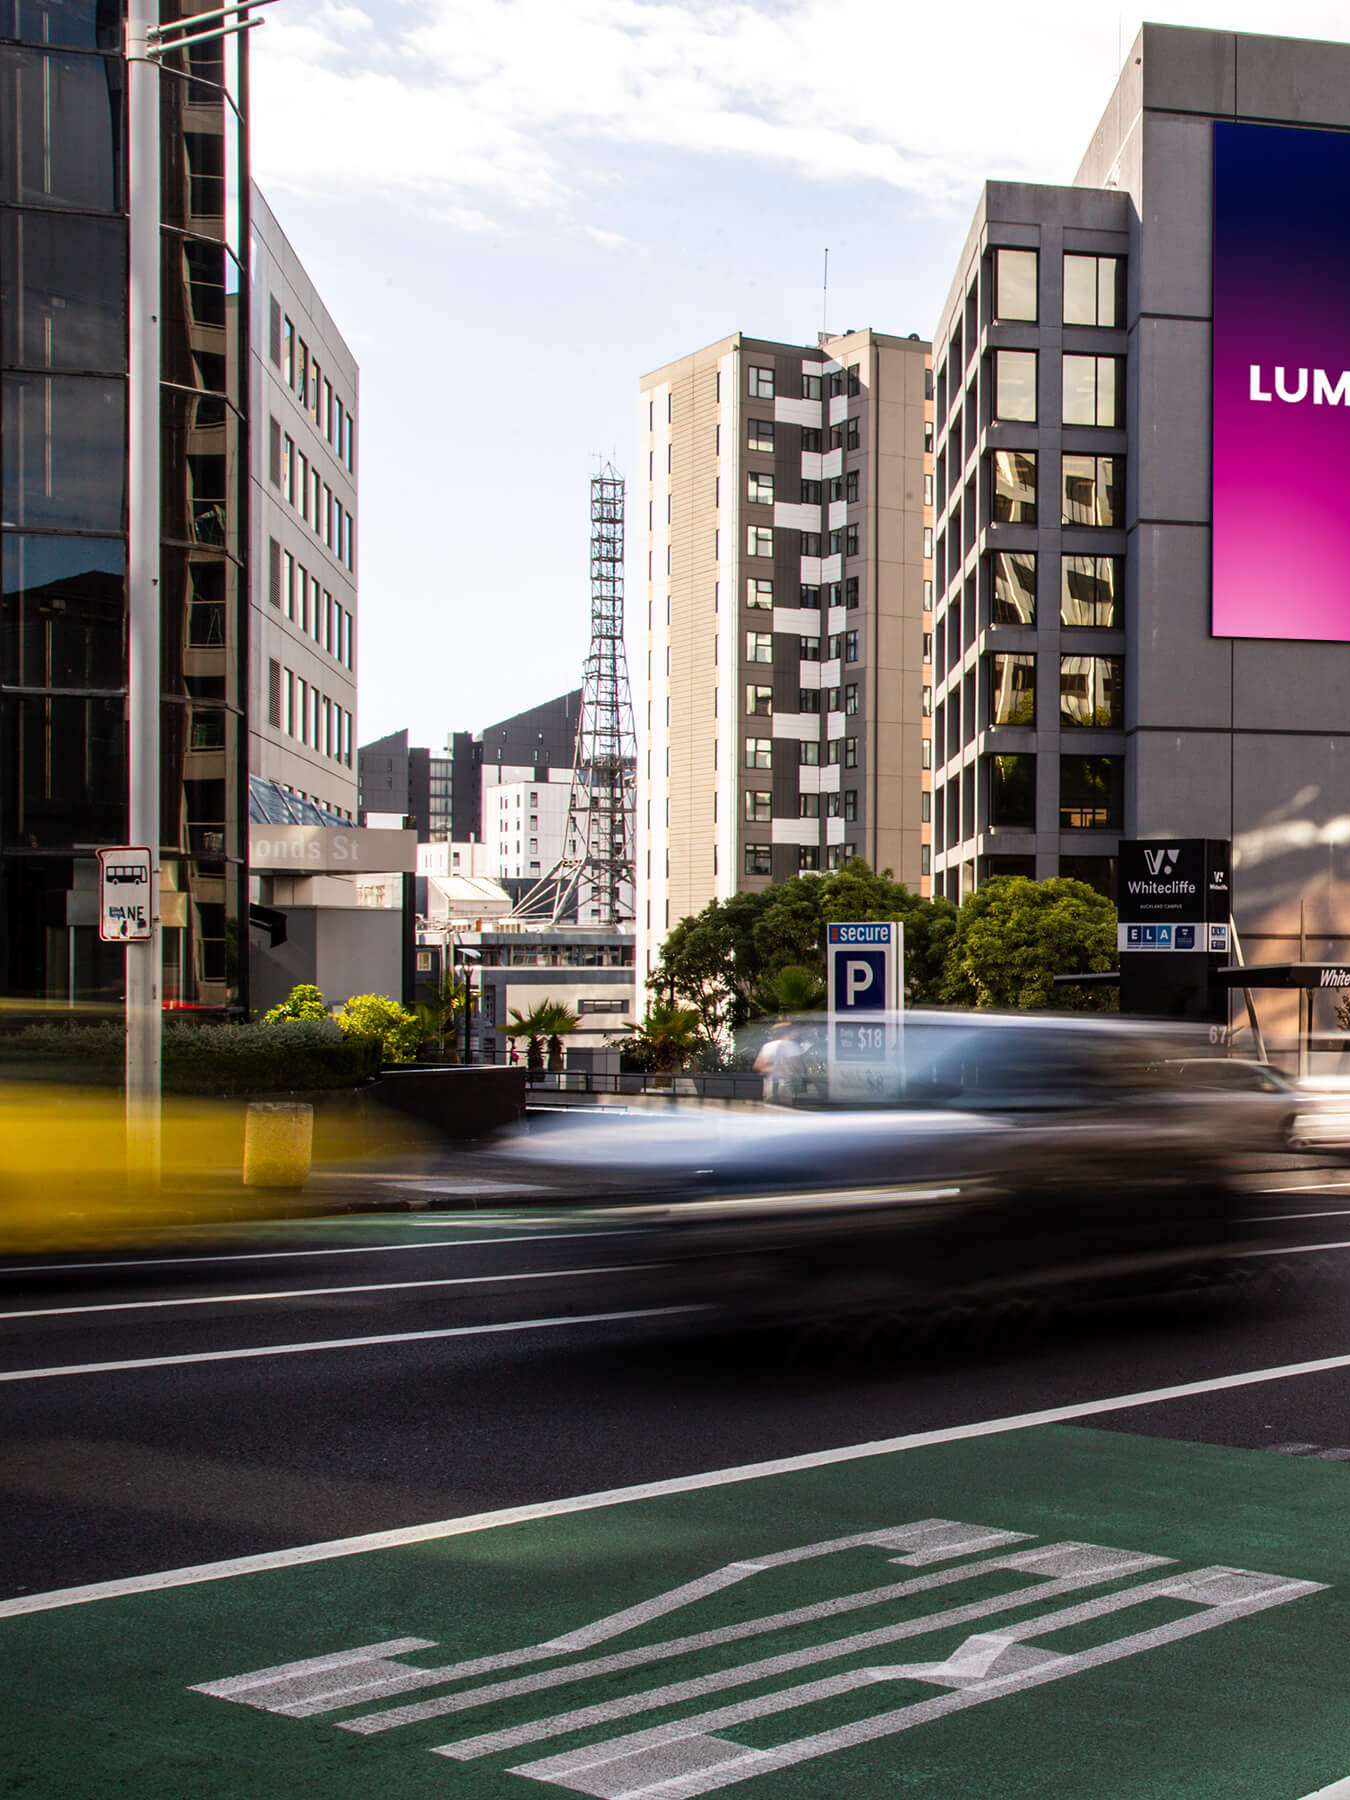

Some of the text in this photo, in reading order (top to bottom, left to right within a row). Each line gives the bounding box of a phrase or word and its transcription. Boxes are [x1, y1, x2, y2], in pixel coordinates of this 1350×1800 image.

[251, 835, 360, 860] onds St
[1127, 880, 1196, 895] Whitecliffe
[840, 926, 889, 941] secure
[846, 960, 873, 1005] P
[1208, 1025, 1227, 1045] 67
